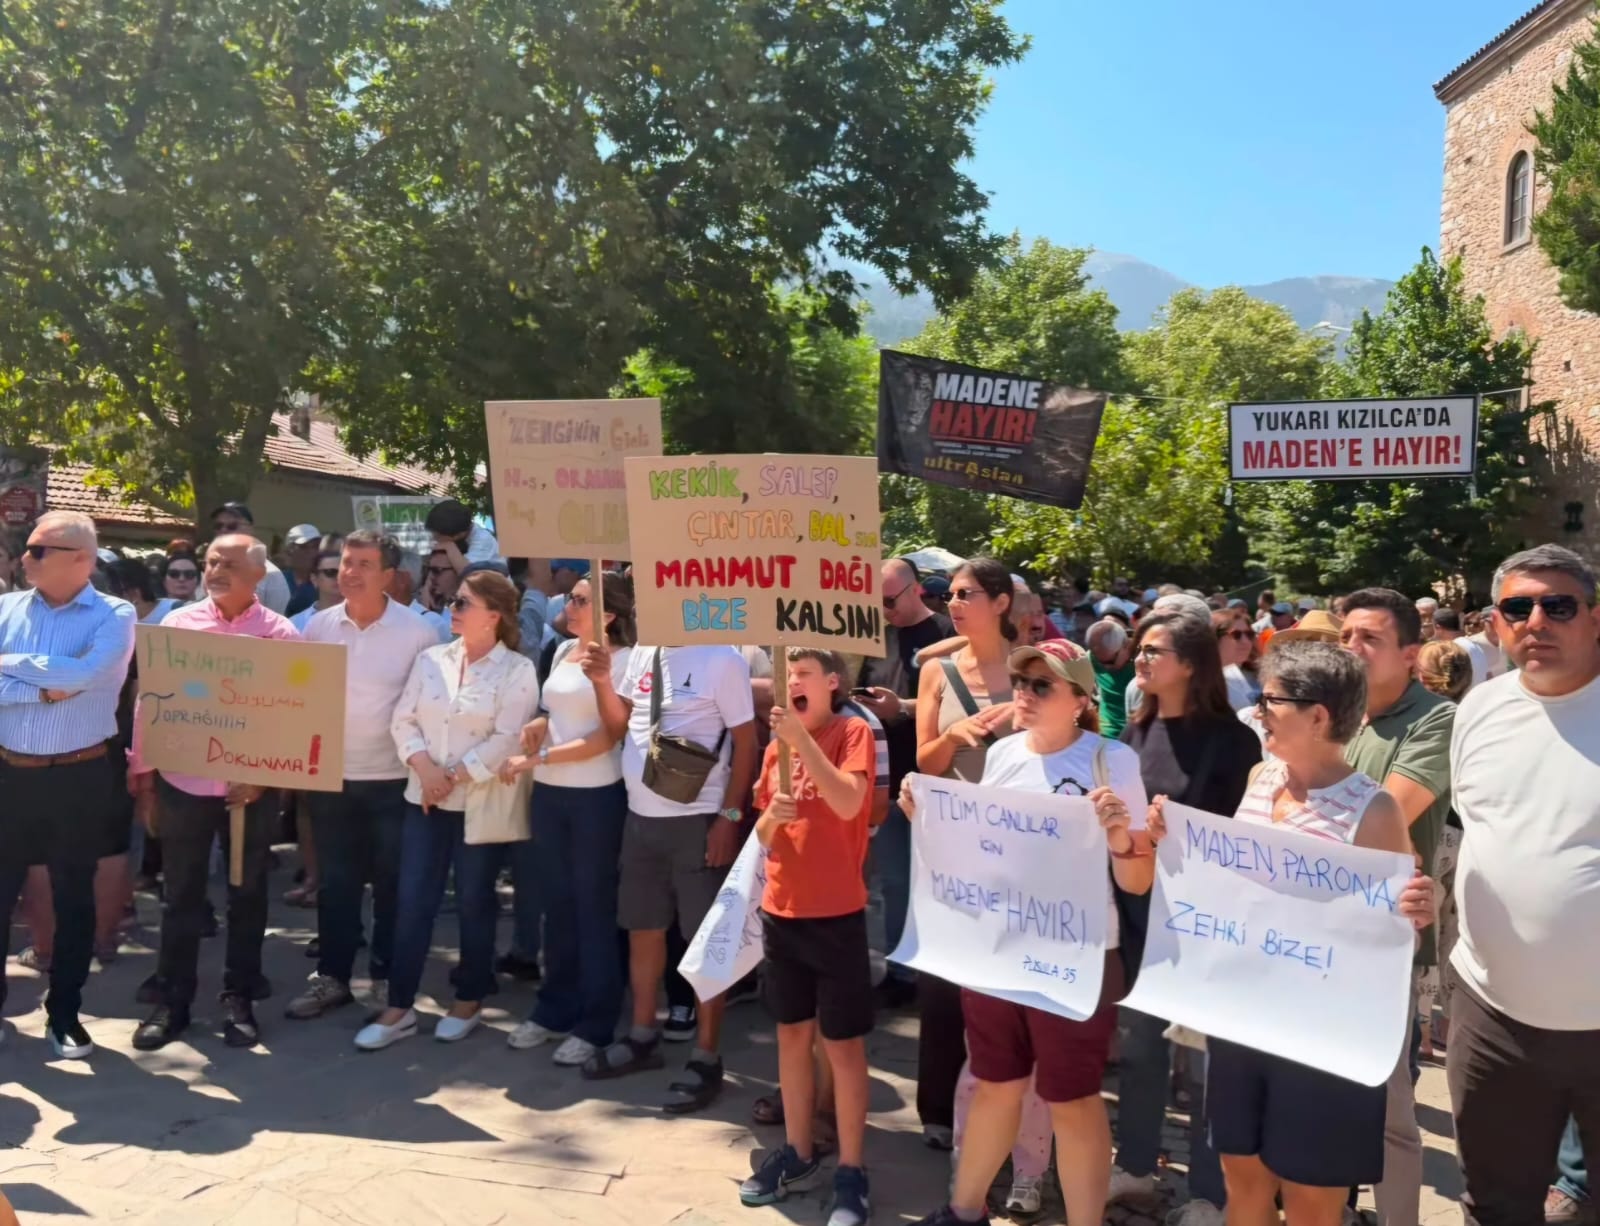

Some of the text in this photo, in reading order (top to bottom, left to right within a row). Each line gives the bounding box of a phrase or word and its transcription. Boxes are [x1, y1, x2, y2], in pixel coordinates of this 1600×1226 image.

[934, 372, 1042, 409] MADENE
[929, 400, 1038, 444] HAYIR!
[1252, 406, 1451, 432] YUKARI KIZILCA'DA
[1243, 435, 1461, 470] MADEN'E HAYIR!
[649, 460, 838, 504] KEKİK, SALEP,
[688, 510, 804, 547] ÇINTAR,
[655, 554, 873, 595] MAHMUT DAĞI
[682, 592, 880, 643] BİZE KALSIN!
[930, 789, 979, 824] TÜM
[931, 869, 1001, 913] MADENE
[1165, 900, 1247, 946] ZEHRİ
